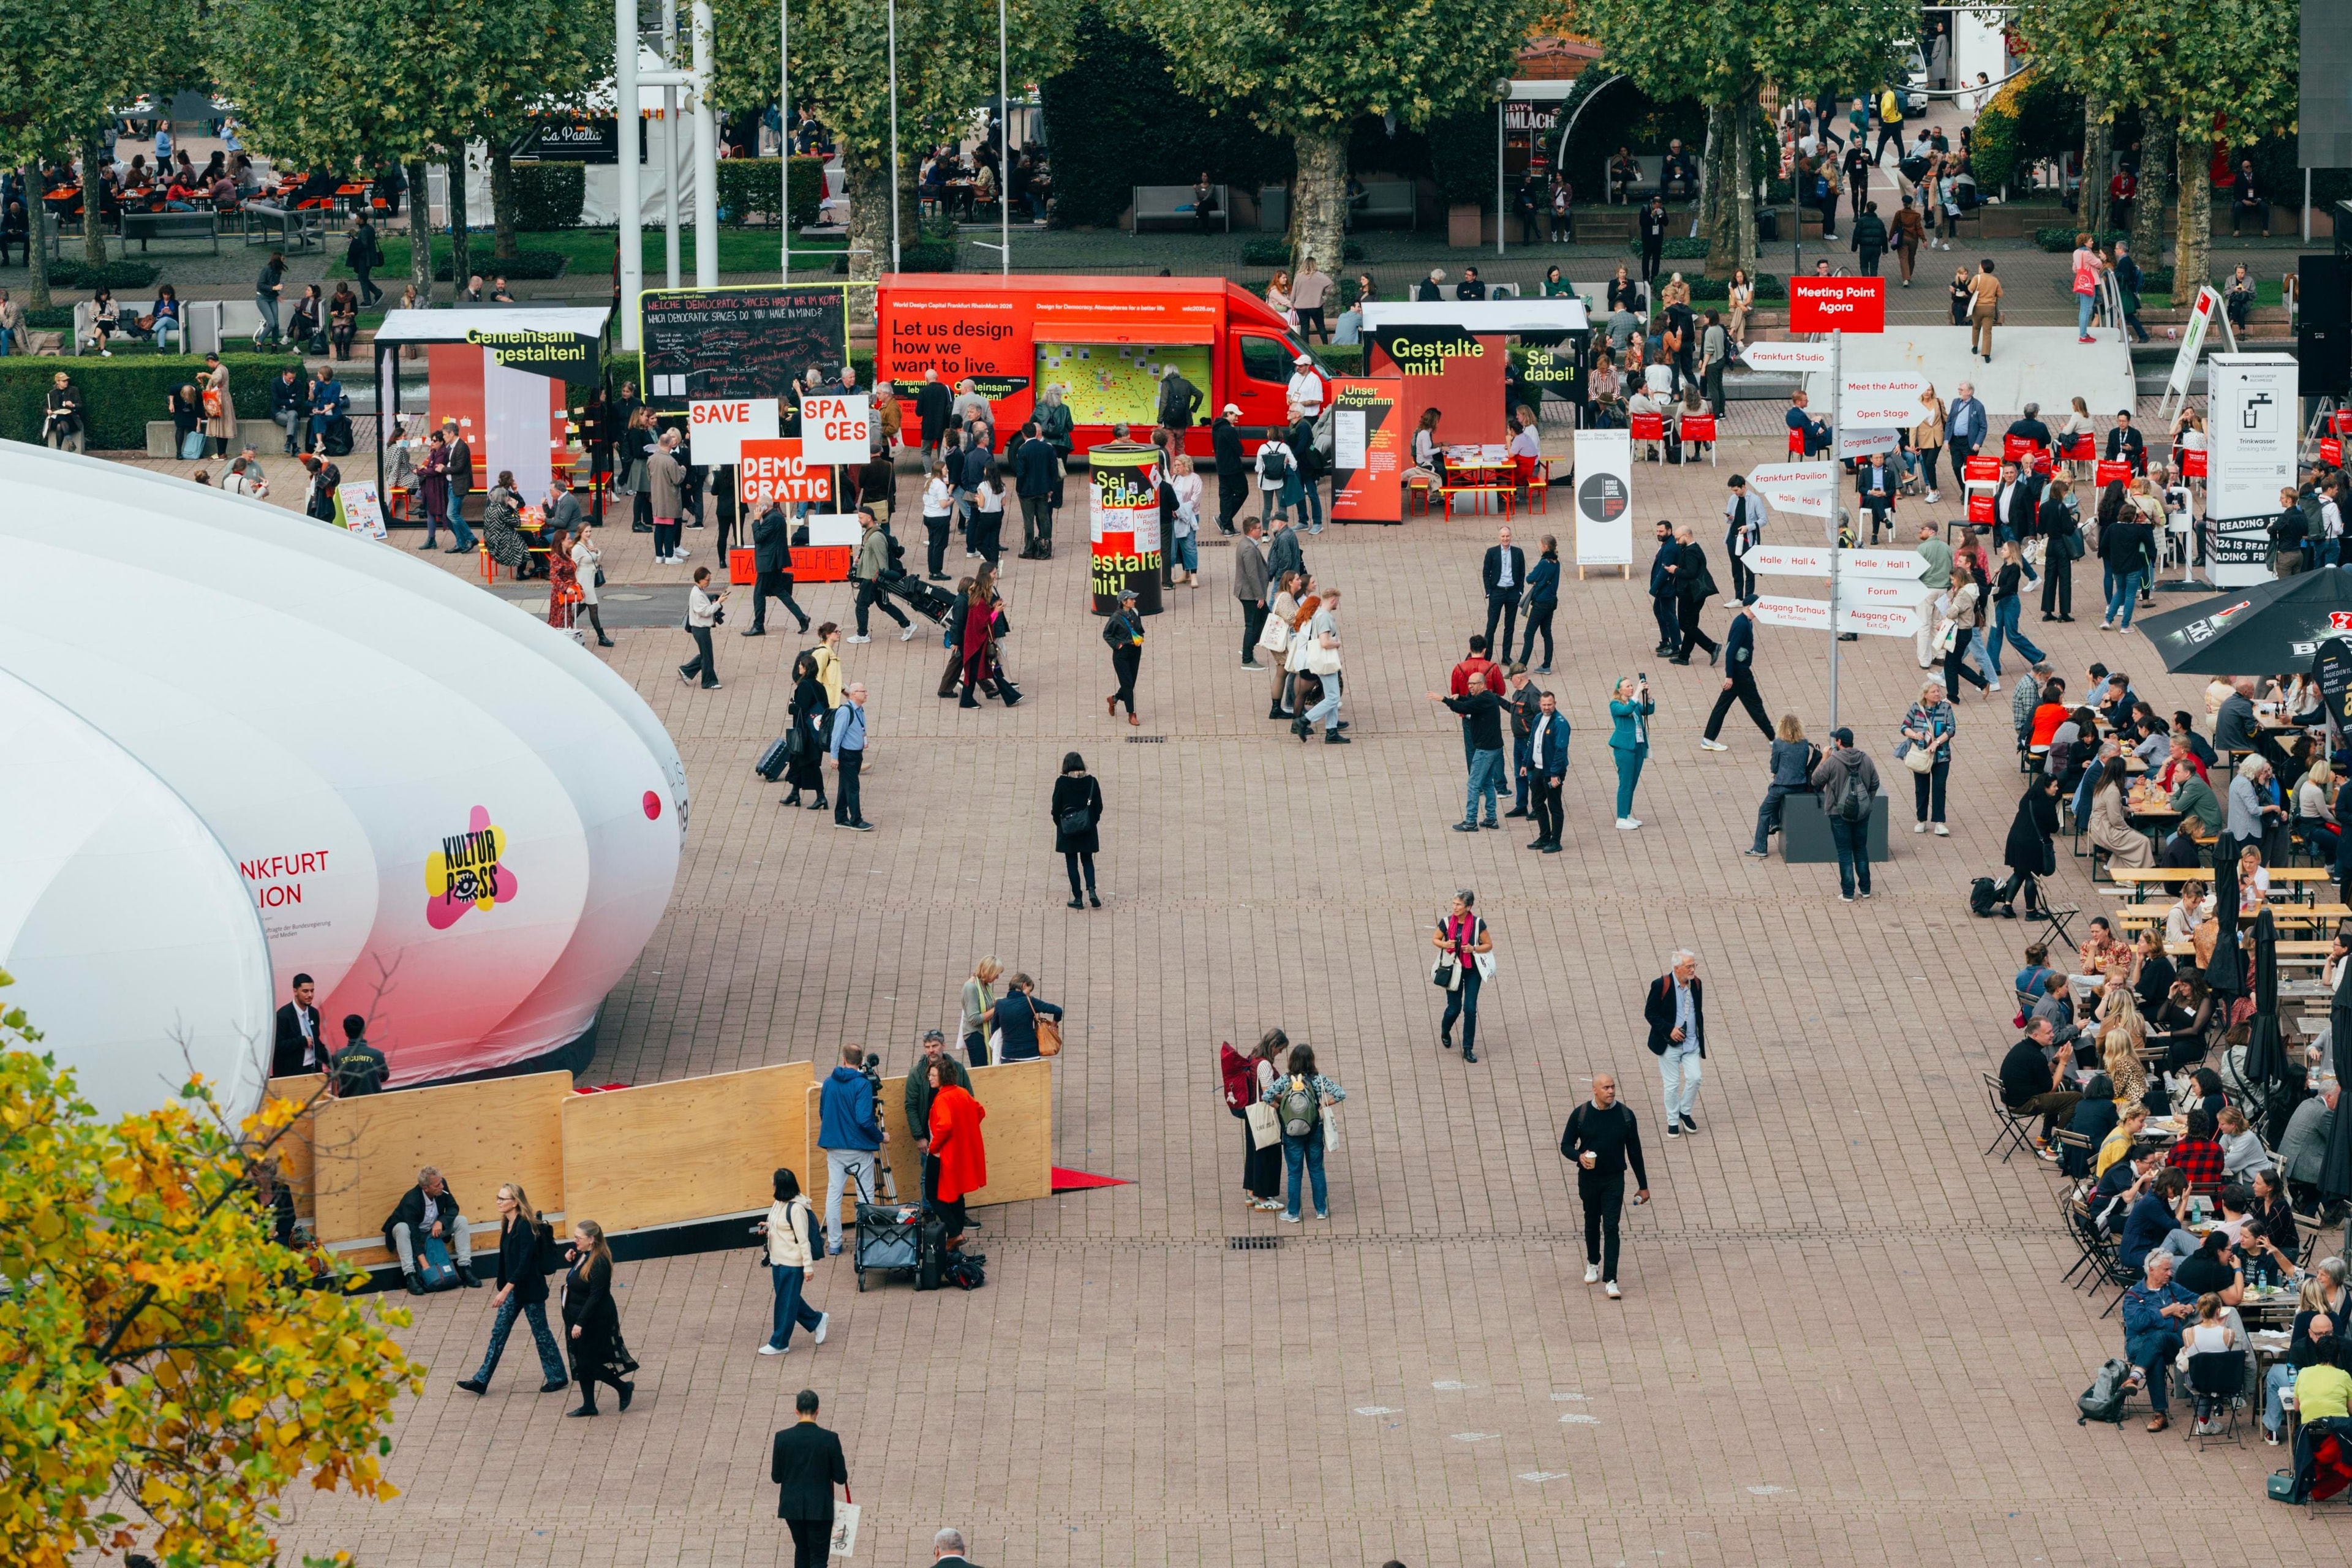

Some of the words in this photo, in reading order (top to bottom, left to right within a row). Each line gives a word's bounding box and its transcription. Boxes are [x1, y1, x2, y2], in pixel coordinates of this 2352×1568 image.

[541, 126, 560, 141] La
[1797, 287, 1844, 300] Meeting
[1846, 287, 1875, 297] Point
[647, 300, 681, 311] WELCHE
[685, 298, 739, 310] DEMOCRATIC
[742, 297, 769, 307] SPACES
[772, 296, 791, 307] HABT
[794, 295, 806, 306] IHR
[808, 295, 818, 305] IM
[818, 294, 841, 307] KOPF?
[1818, 301, 1854, 314] Agora
[647, 313, 666, 324] WHICH
[668, 312, 709, 324] DEMOCRATIC
[711, 311, 737, 322] SPACES
[739, 311, 749, 321] DO
[753, 309, 765, 319] YOU
[769, 309, 786, 318] HAVE
[788, 309, 796, 318] IN
[796, 307, 823, 318] MIND?
[466, 327, 575, 344] Gemeinsam
[893, 319, 922, 336] Let
[927, 324, 948, 336] us
[952, 320, 1013, 341] design
[892, 338, 930, 354] how
[935, 343, 962, 354] we
[1392, 338, 1484, 358] Gestalte
[494, 344, 585, 366] gestalten!
[1527, 350, 1554, 366] Sei
[1753, 352, 1793, 361] Frankfurt
[1796, 353, 1825, 362] Studio
[892, 358, 937, 372] want
[941, 359, 959, 373] to
[965, 357, 1000, 373] live.
[1404, 358, 1444, 376] mit!
[710, 373, 747, 388] Imagination
[1524, 367, 1574, 381] dabei!
[1345, 385, 1379, 395] Unser
[1338, 394, 1394, 407] Programm
[693, 403, 750, 424] SAVE
[804, 399, 847, 420] SPA
[1856, 410, 1881, 419] Open
[1883, 409, 1909, 419] Stage
[824, 421, 867, 441] CES
[1844, 438, 1871, 448] Congress
[1873, 435, 1894, 444] Center
[744, 456, 807, 478] DEMO
[1096, 471, 1125, 489] Sei
[1755, 474, 1793, 483] Frankfurt
[1795, 472, 1827, 481] Pavilion
[341, 488, 366, 496] Gestalte
[744, 478, 827, 500] CRATIC
[1779, 494, 1796, 503] Halle
[1802, 496, 1815, 505] Hall
[1816, 498, 1821, 507] 6
[2220, 519, 2264, 531] READ!NG
[2234, 541, 2242, 550] IS
[1091, 552, 1163, 572] estalte
[1093, 574, 1125, 595] mit!
[1758, 602, 1793, 613] Ausgang
[1795, 605, 1826, 615] Torhaus
[1851, 611, 1887, 622] Ausgang
[1889, 613, 1907, 623] City
[442, 829, 497, 870] KULTUR
[256, 884, 302, 908] ION
[292, 921, 331, 930] Bundesregierung
[341, 1054, 374, 1064] SECURITY
